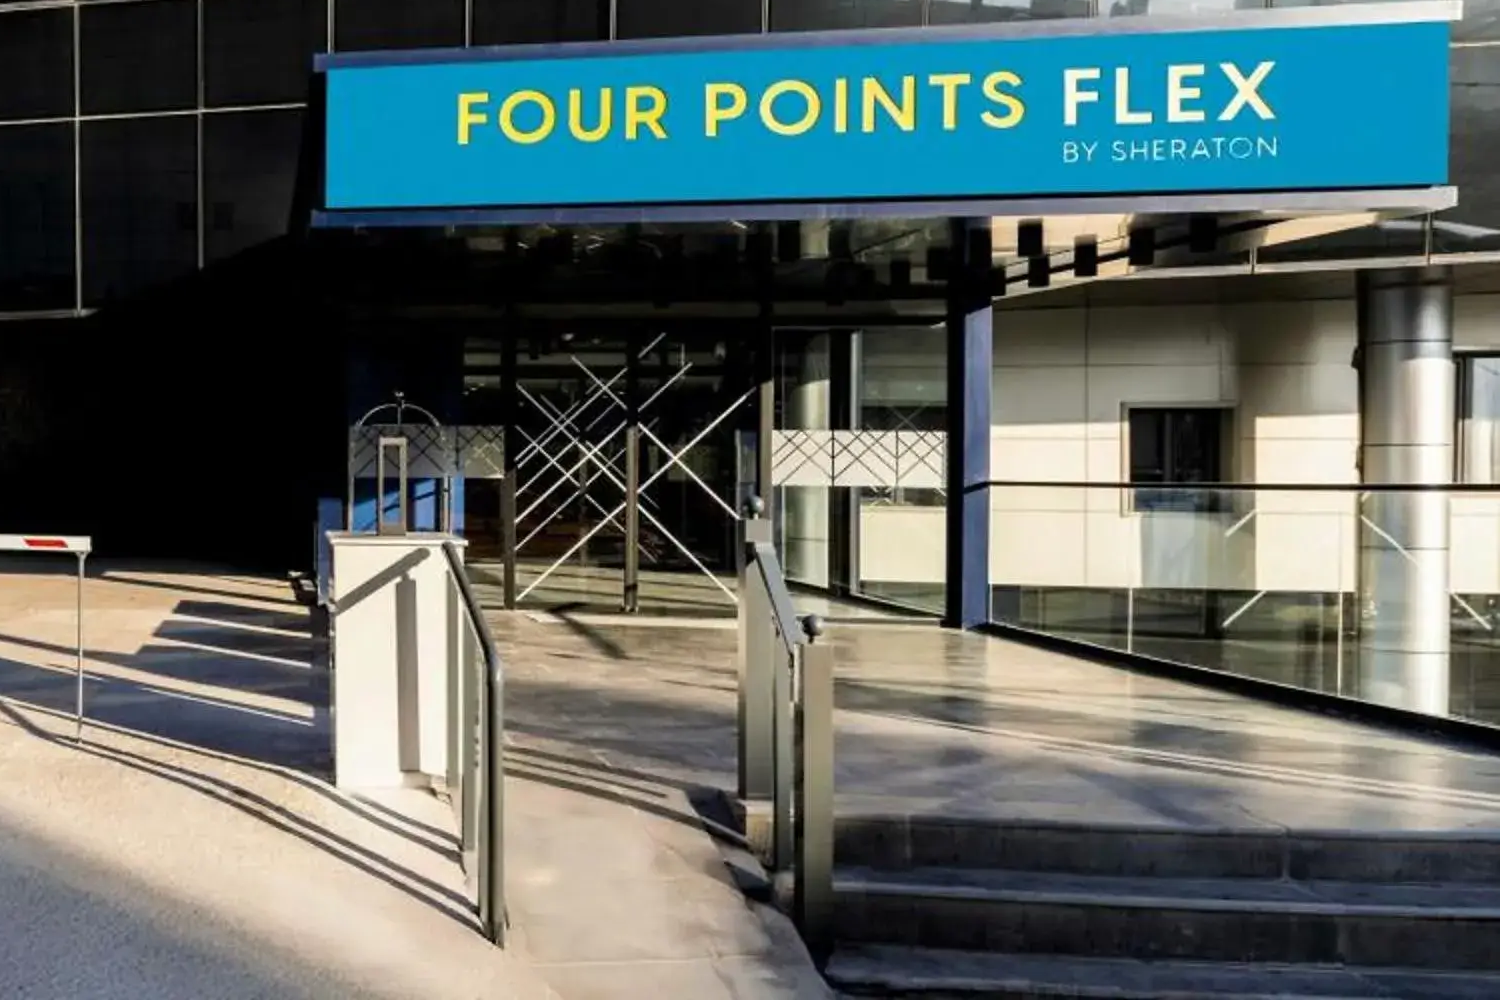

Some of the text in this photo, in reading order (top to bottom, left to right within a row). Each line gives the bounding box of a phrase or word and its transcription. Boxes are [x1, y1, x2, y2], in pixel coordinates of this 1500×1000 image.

[457, 61, 1276, 145] FOUR POINTS FLEX
[1063, 136, 1277, 163] BY SHERATON
